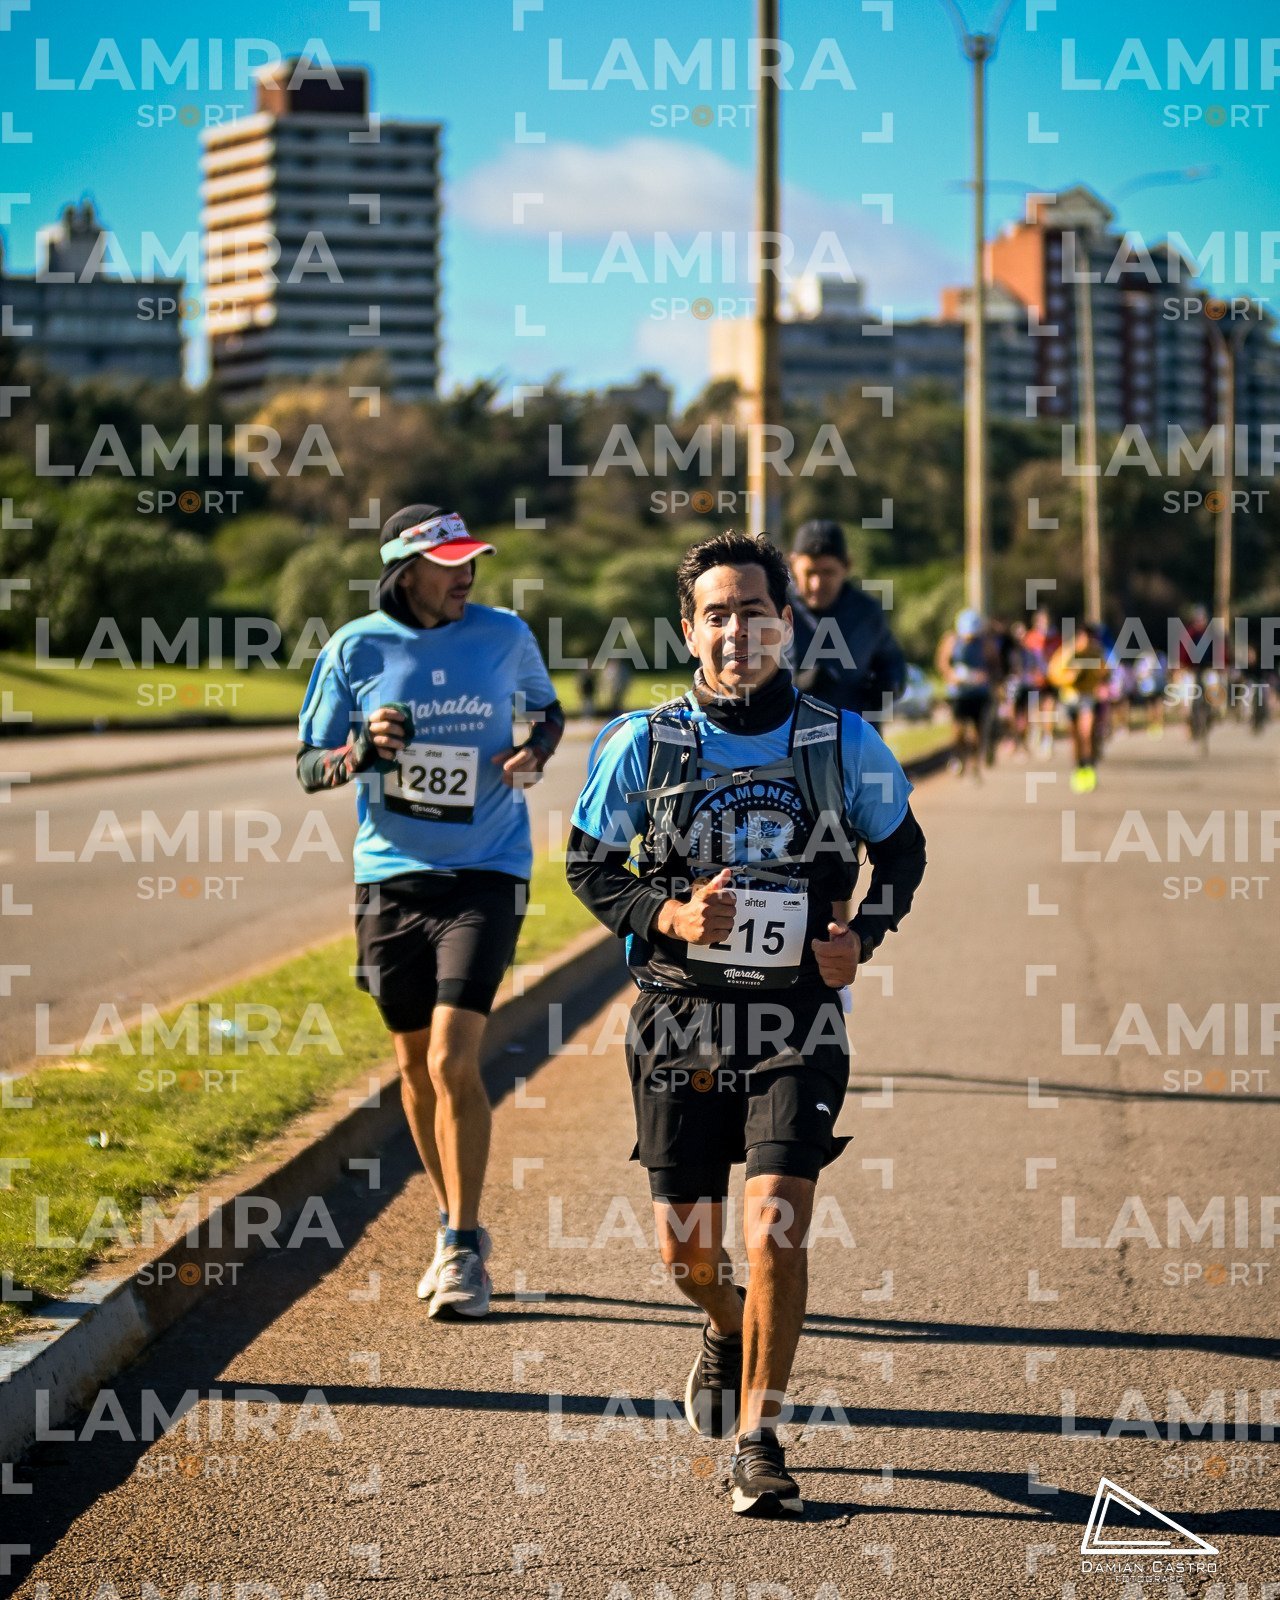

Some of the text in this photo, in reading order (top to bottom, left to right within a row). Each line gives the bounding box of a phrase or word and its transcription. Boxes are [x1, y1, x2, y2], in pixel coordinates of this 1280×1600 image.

[414, 721, 485, 736] ONTEVIDEO
[397, 763, 468, 796] 1282
[709, 784, 802, 814] RAMONES
[744, 897, 767, 909] antel
[723, 968, 766, 981] Maratón
